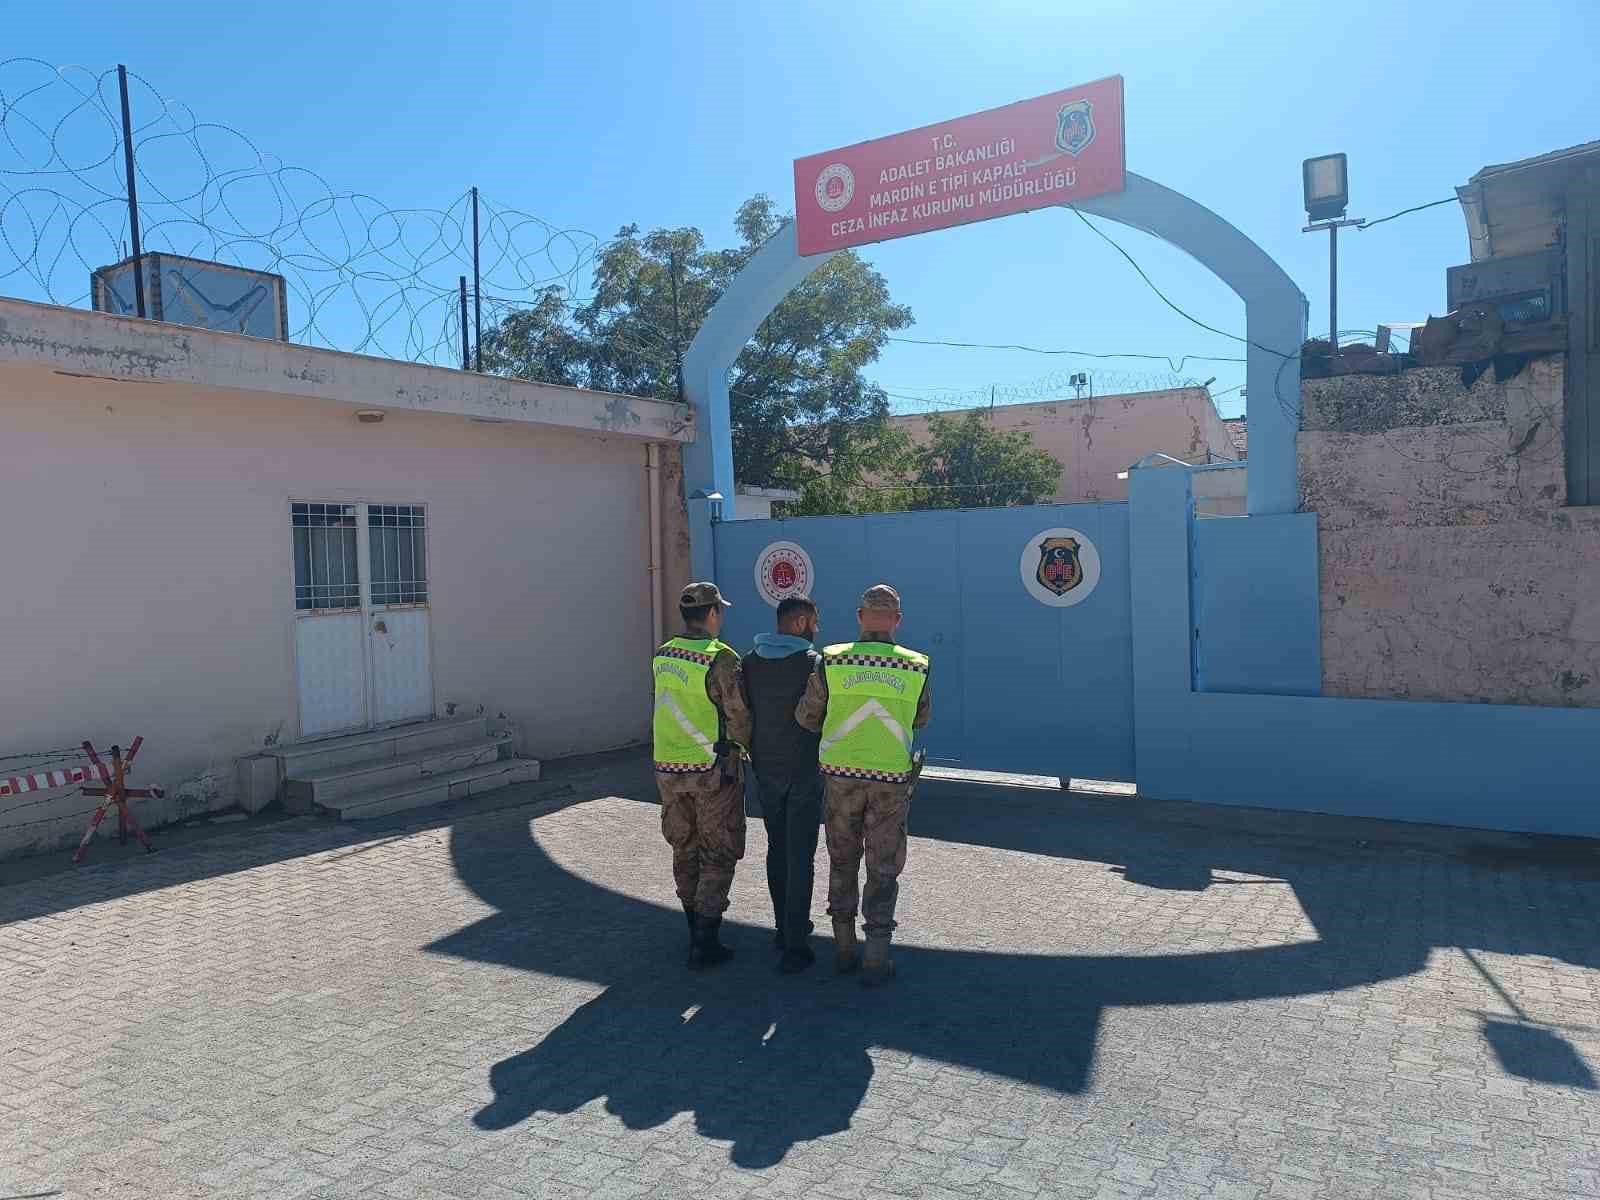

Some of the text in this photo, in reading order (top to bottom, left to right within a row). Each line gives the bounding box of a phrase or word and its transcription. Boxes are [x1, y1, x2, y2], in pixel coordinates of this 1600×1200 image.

[879, 137, 1015, 184] ADALET BAKANLIĞI
[931, 134, 957, 151] T.C.
[831, 167, 1076, 236] CEZA İNFAZ KURUMU MÜDÜRLÜĞÜ
[870, 183, 925, 209] MARDİN
[929, 181, 937, 195] E
[941, 170, 968, 193] TİPİ
